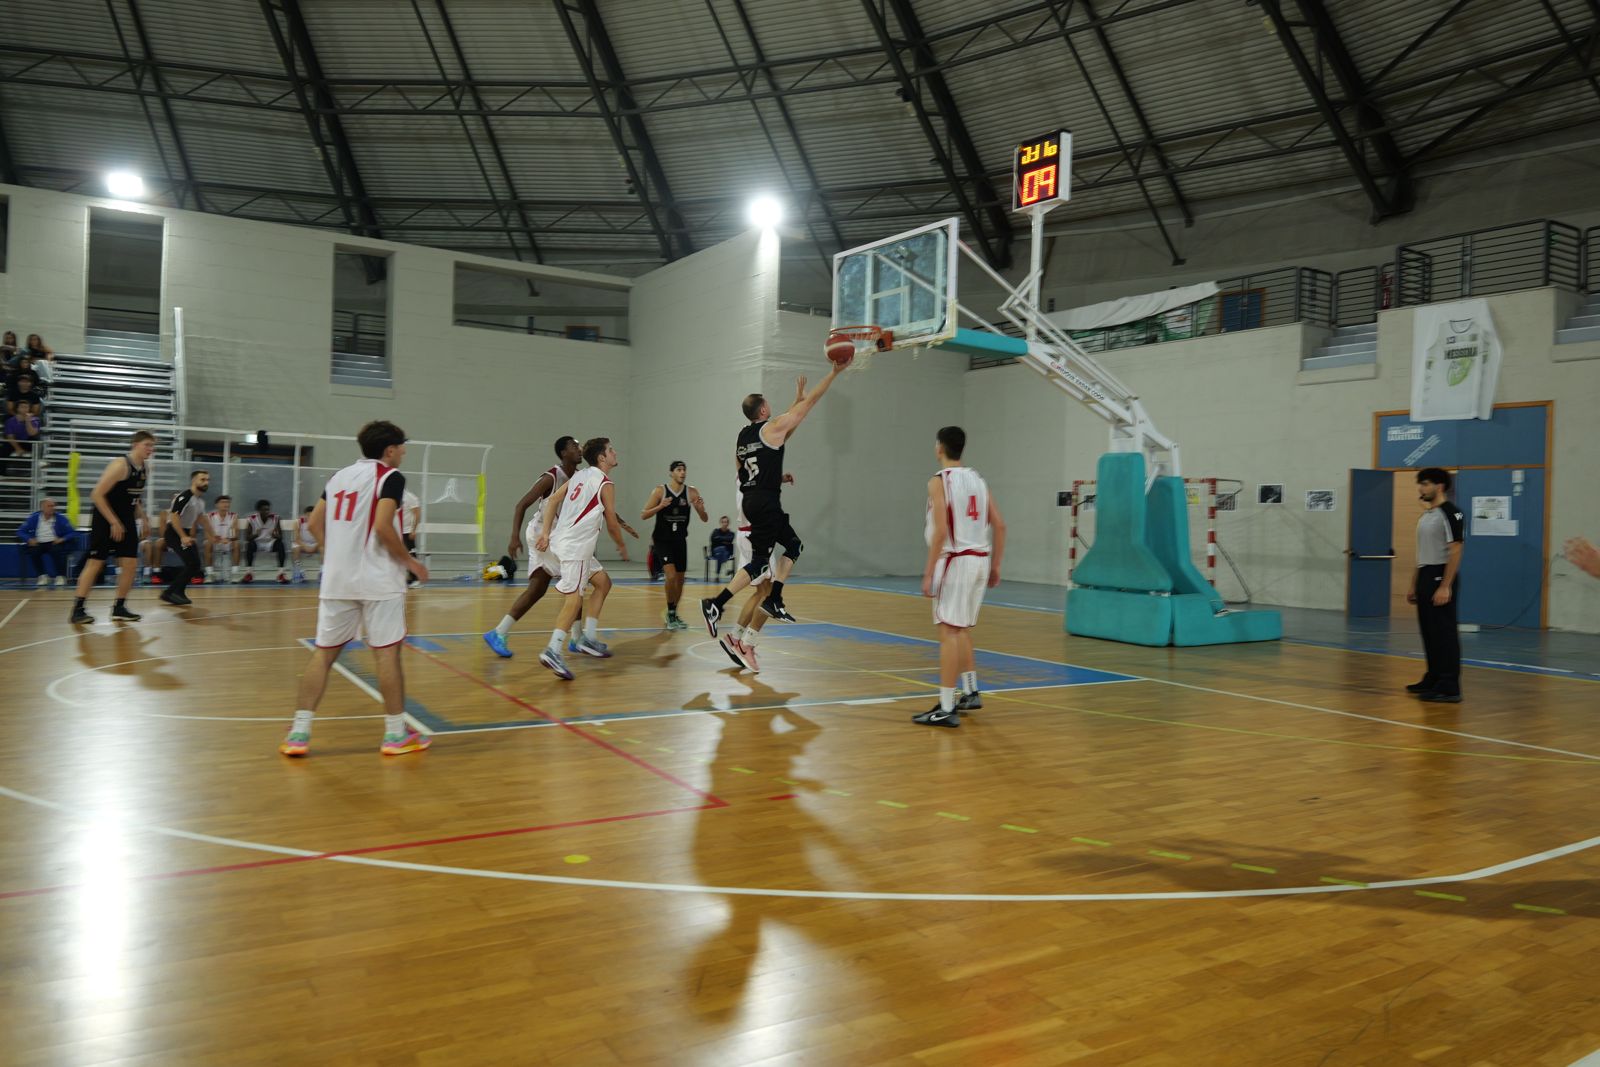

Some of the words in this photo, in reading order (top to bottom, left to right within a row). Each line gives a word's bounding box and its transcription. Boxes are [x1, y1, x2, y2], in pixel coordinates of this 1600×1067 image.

[1022, 164, 1057, 204] 09
[334, 489, 359, 522] 11
[570, 482, 583, 501] 5
[966, 495, 979, 521] 4
